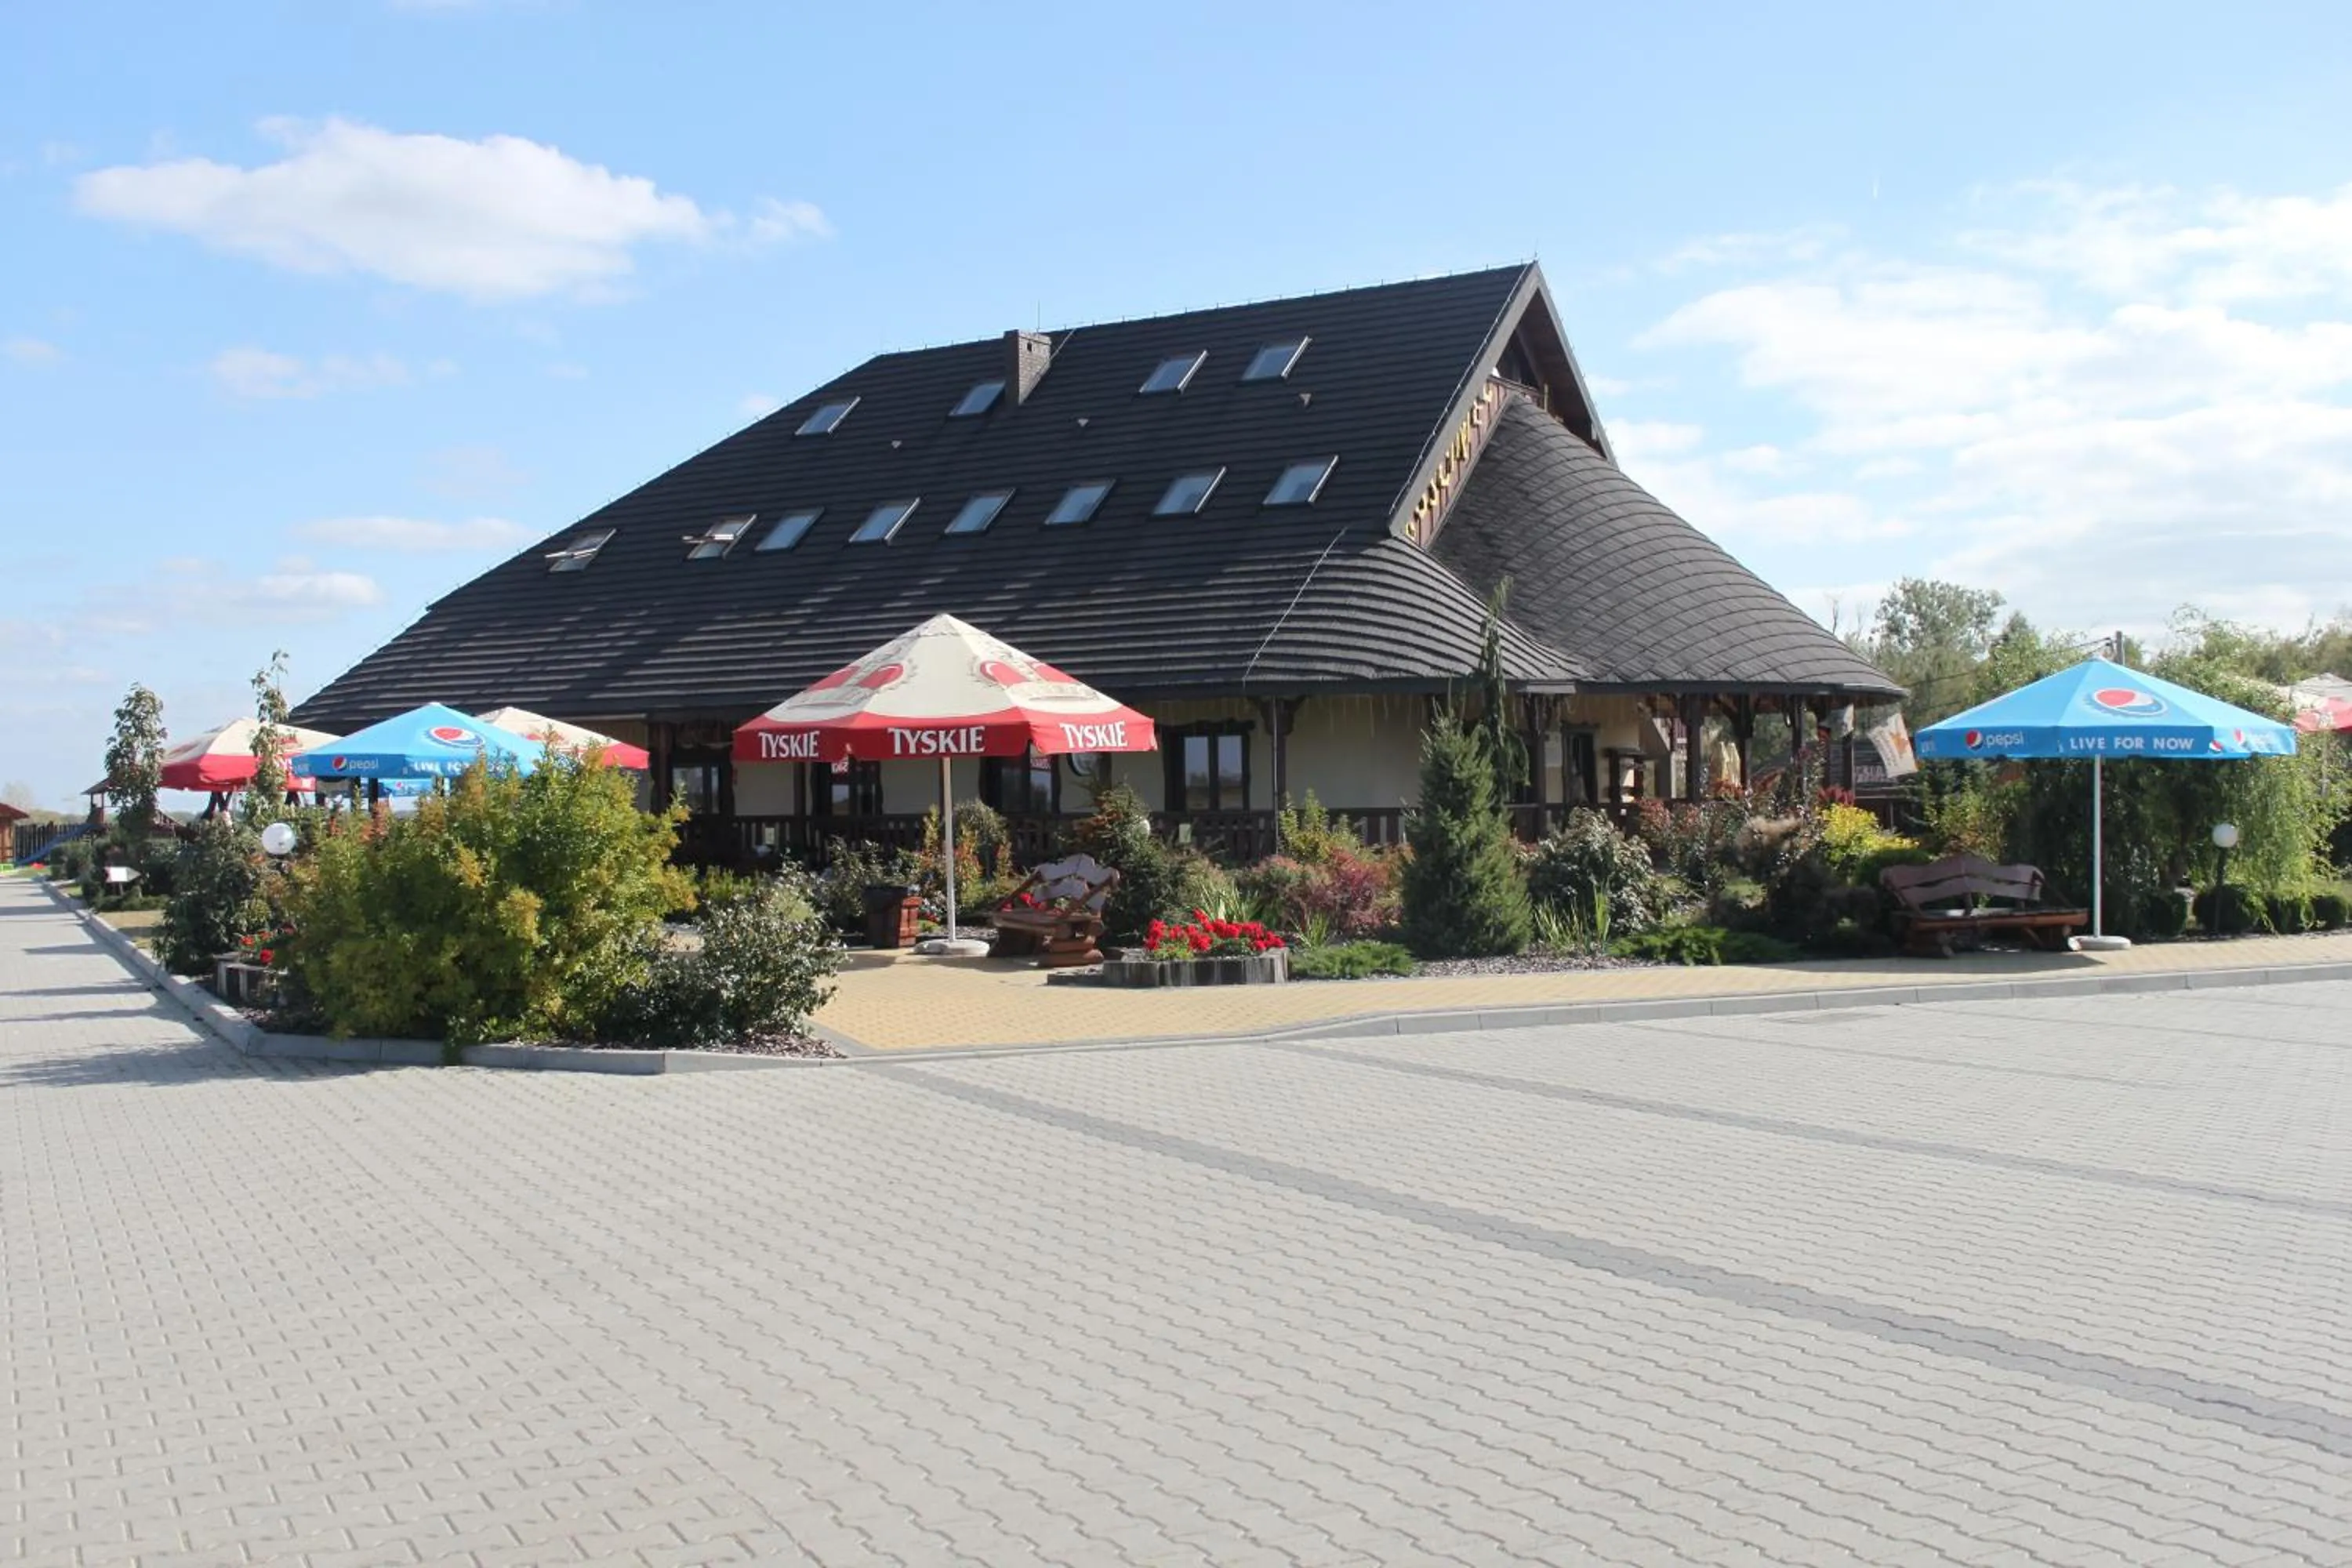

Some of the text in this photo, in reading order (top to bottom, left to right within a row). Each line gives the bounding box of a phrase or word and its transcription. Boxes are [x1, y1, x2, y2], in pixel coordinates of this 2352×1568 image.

[758, 730, 821, 759] TYSKIE
[887, 725, 985, 755] TYSKIE
[1059, 720, 1128, 749] TYSKIE
[1985, 731, 2024, 748] pepsi
[2069, 736, 2194, 750] LIVE FOR NOW
[349, 757, 379, 771] pepsi
